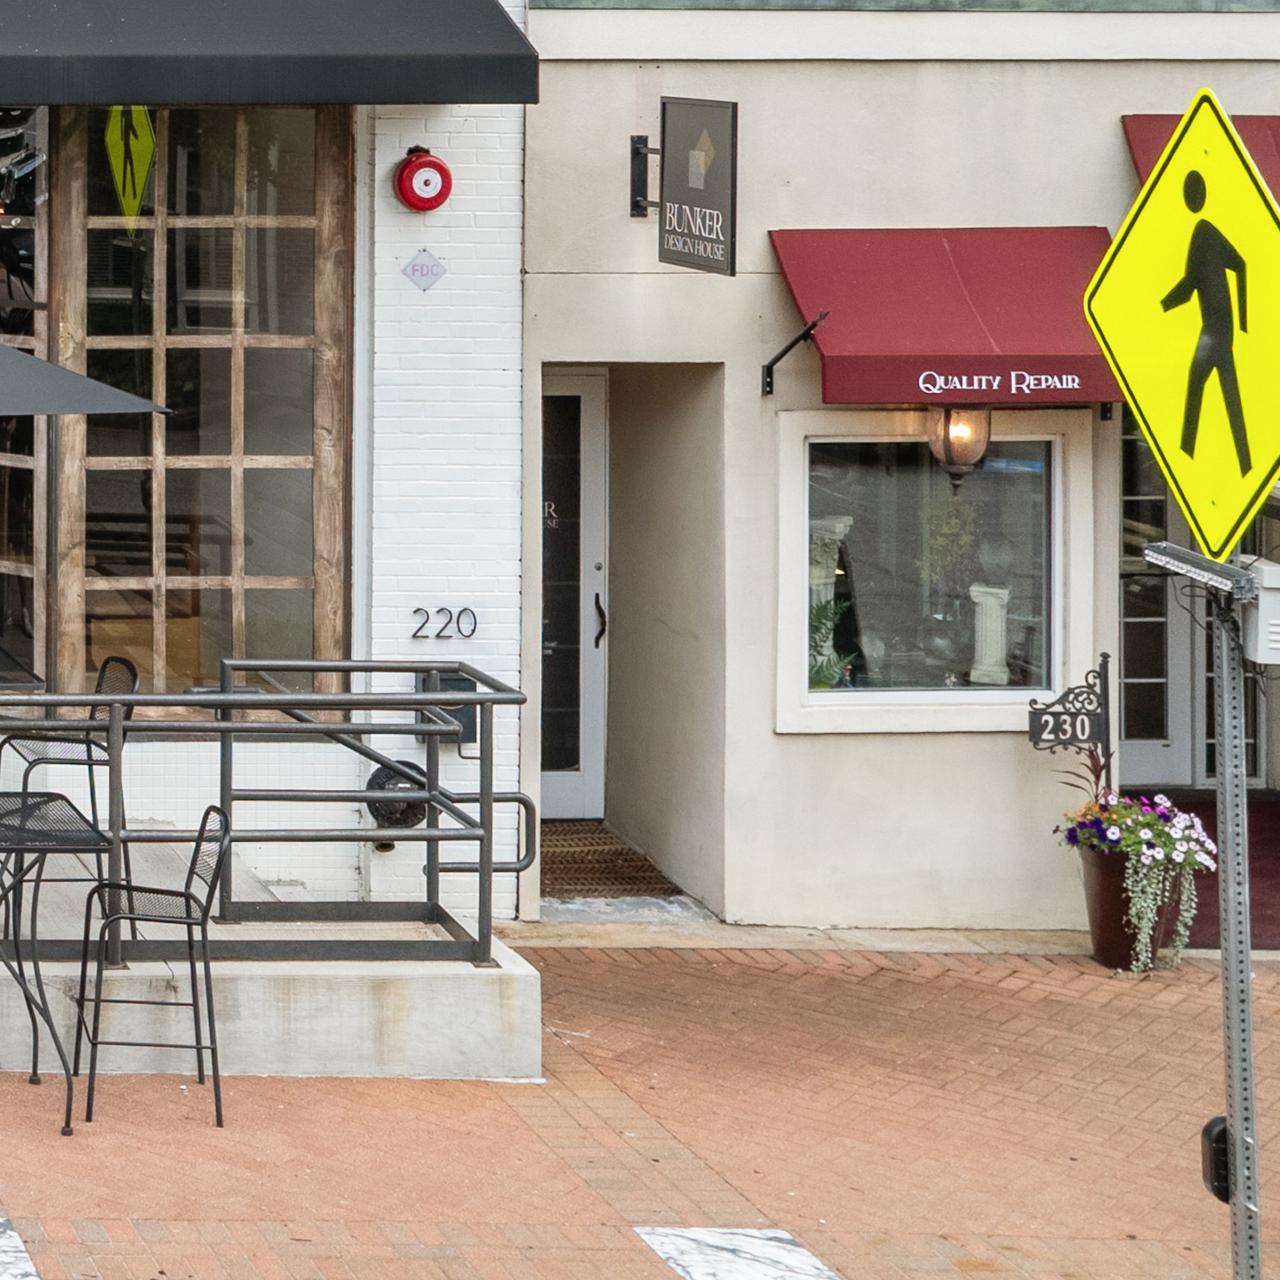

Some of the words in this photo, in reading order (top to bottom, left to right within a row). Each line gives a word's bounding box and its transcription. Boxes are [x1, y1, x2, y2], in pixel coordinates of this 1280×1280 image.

[665, 203, 724, 241] BUNKER
[664, 234, 694, 255] DESIGN
[694, 240, 725, 261] HOUSE
[411, 264, 439, 277] FDC
[919, 371, 1001, 394] QUALITY
[1010, 371, 1080, 394] REPAIR
[412, 608, 477, 639] 220
[1041, 714, 1090, 740] 230
